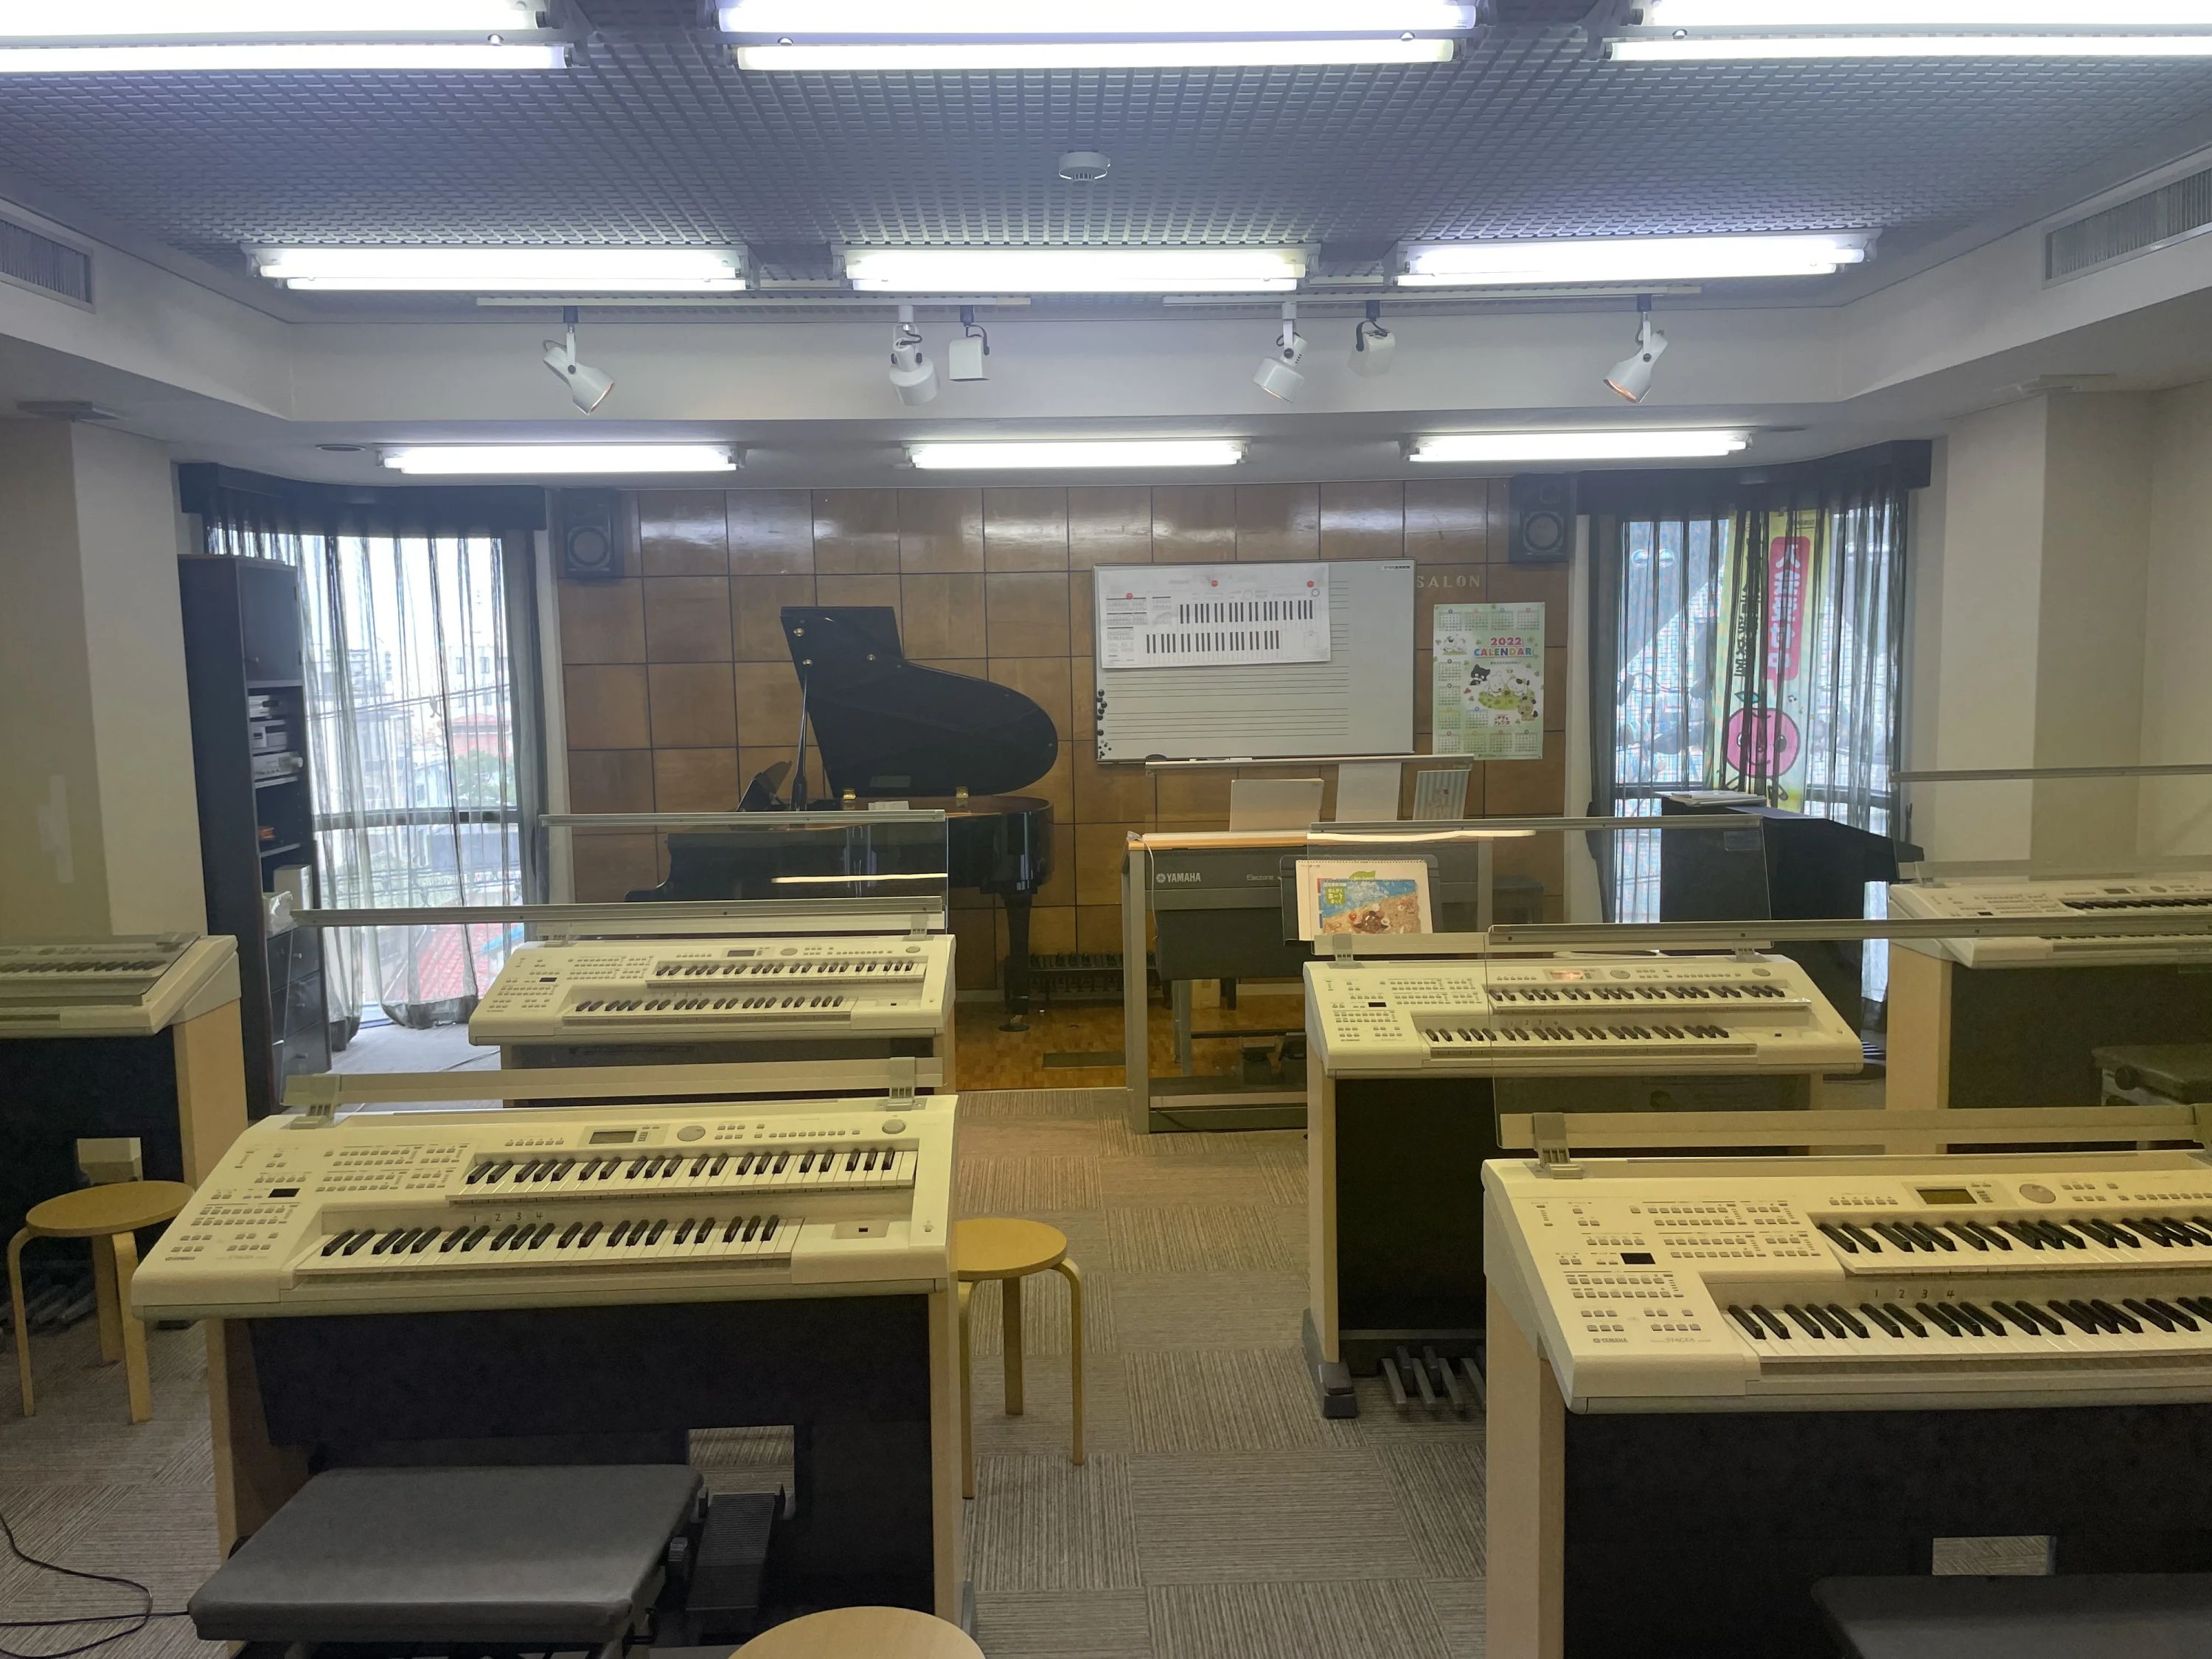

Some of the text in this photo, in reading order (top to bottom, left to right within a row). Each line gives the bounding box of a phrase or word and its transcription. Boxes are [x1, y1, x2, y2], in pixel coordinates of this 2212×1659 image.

[1416, 575, 1480, 588] SALON
[1490, 637, 1522, 646] 2022
[1474, 647, 1533, 656] CALENDAR
[1166, 872, 1201, 883] YAMAHA
[495, 1214, 501, 1222] 2
[516, 1212, 521, 1220] 3
[536, 1211, 543, 1220] 4
[1899, 1289, 1905, 1298] 2
[1921, 1289, 1928, 1298] 3
[1947, 1290, 1955, 1298] 4
